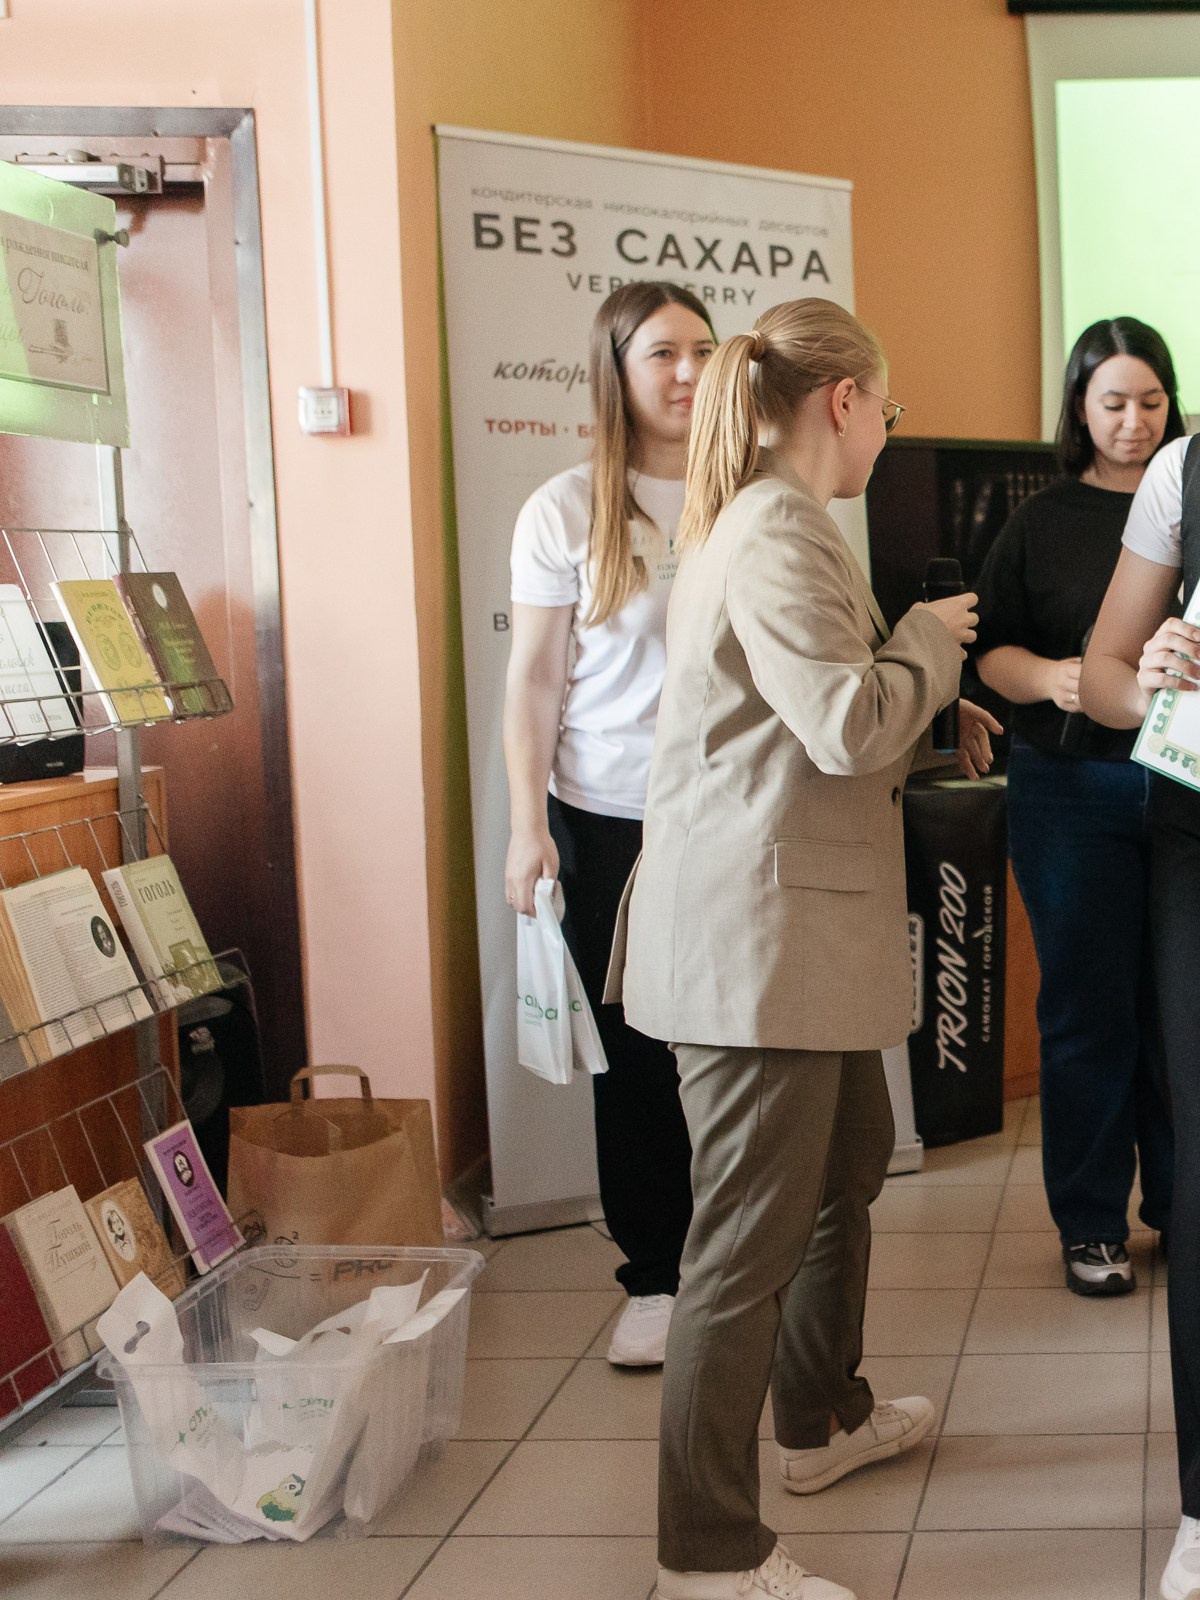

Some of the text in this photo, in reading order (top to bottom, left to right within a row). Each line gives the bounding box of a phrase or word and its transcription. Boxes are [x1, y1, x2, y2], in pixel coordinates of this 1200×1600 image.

[473, 212, 831, 284] БЕЗ САХАРА
[485, 418, 557, 437] ТОРТЫ
[137, 879, 176, 904] ГОГОЛЬ
[936, 861, 969, 1073] TRION 200
[981, 978, 992, 1043] САМОКАТ
